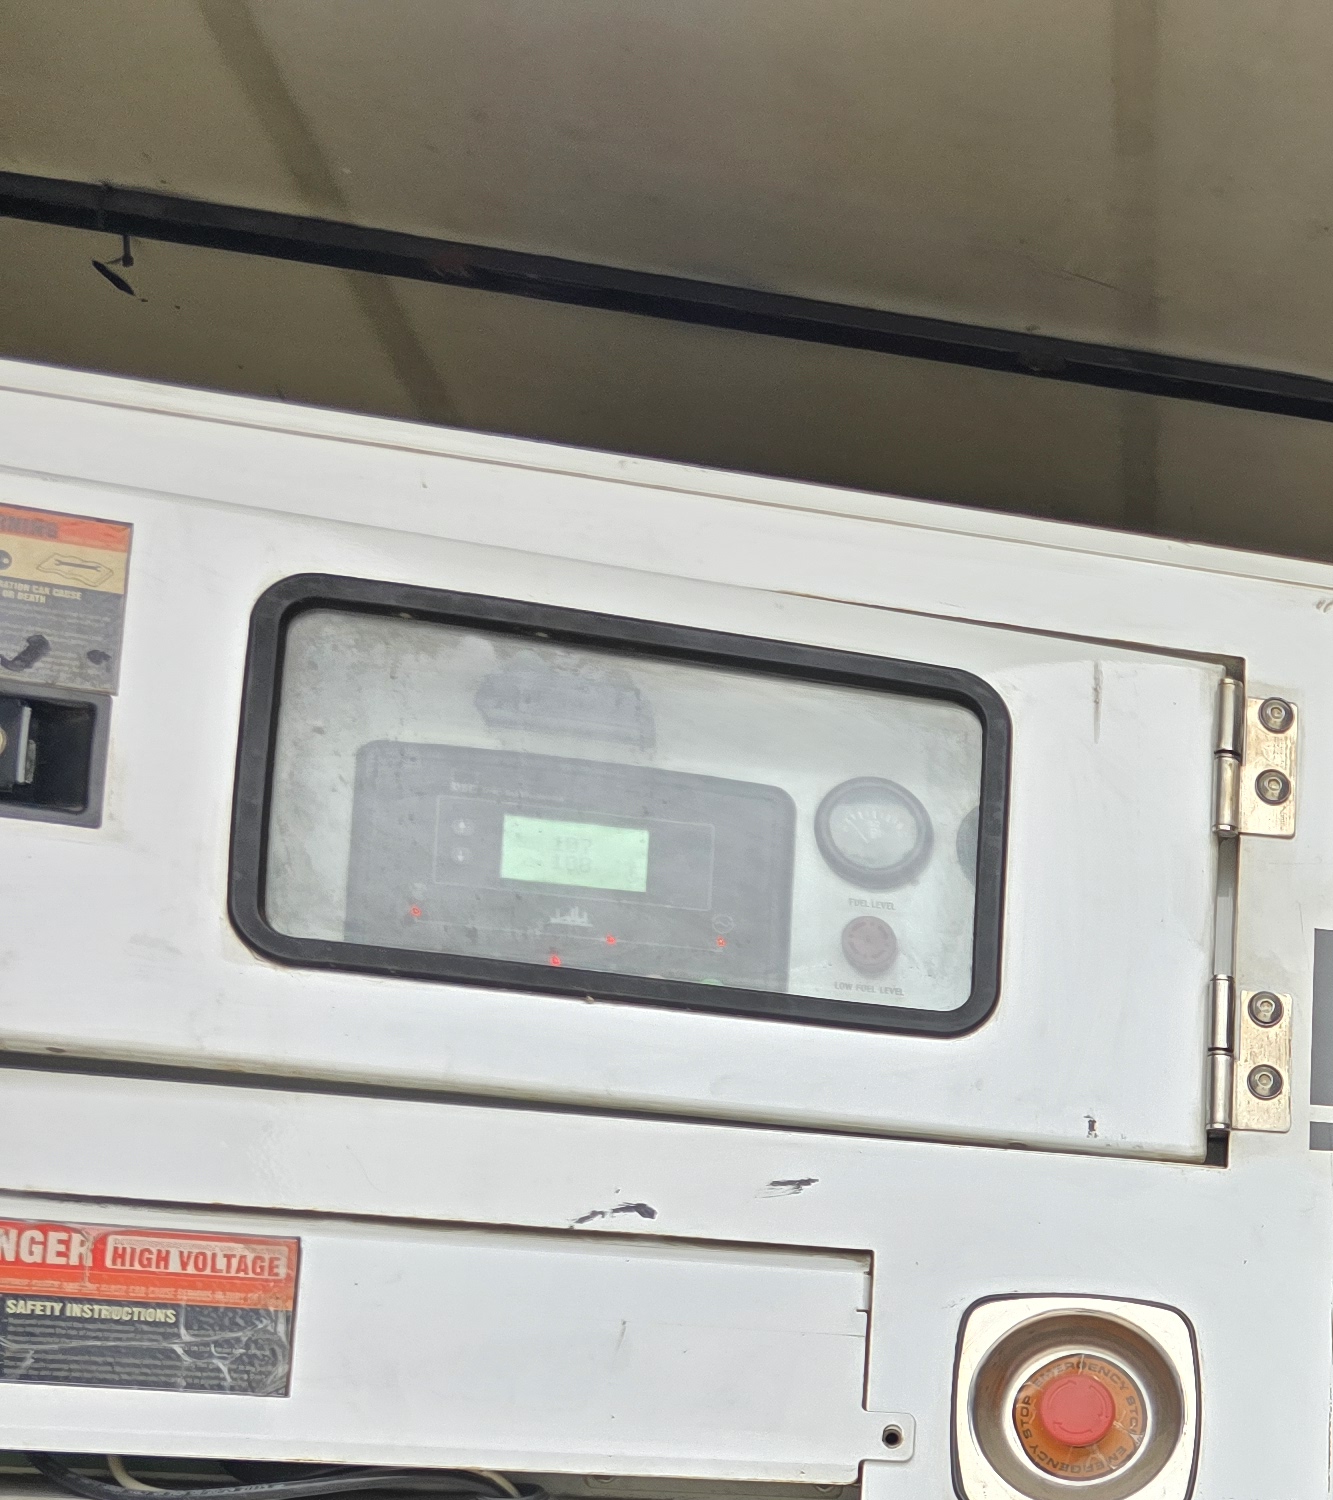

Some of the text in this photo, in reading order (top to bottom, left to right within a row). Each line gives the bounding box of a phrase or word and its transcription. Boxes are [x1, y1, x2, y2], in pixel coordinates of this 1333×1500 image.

[872, 899, 896, 910] LEVEL
[111, 1246, 281, 1276] HIGH VOLTAGE
[6, 1299, 176, 1323] SAFETY INSTRUCTIONS
[1020, 1395, 1033, 1439] STOP
